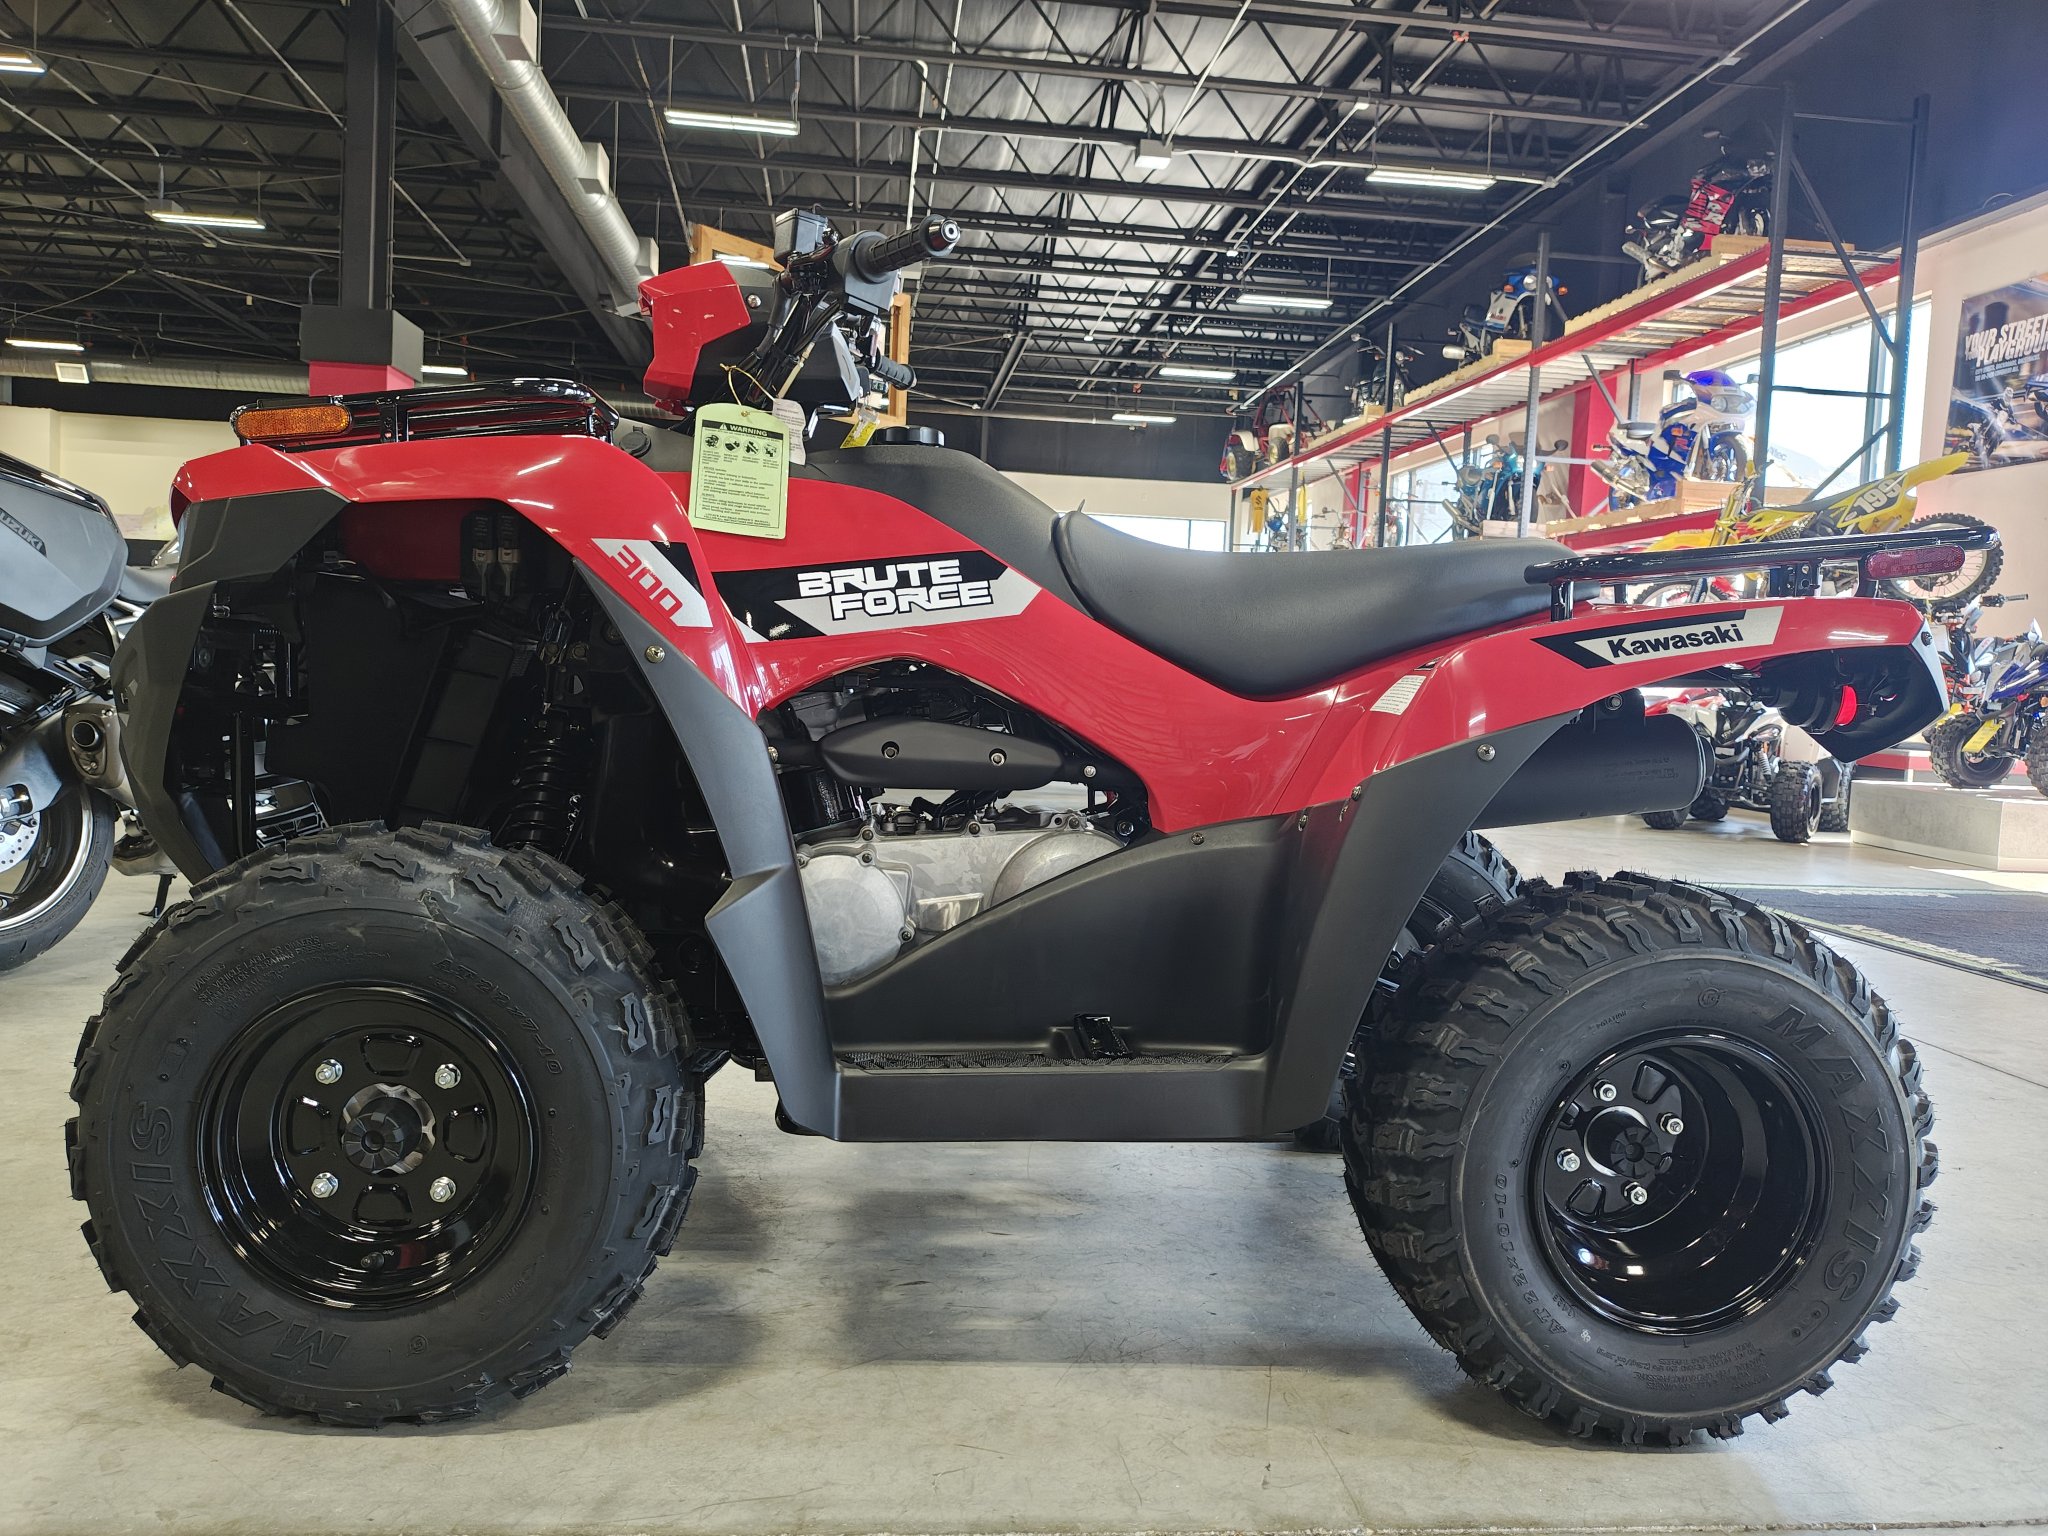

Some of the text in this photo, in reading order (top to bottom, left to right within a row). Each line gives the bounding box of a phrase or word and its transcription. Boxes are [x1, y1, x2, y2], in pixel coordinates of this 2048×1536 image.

[1966, 327, 1998, 355] YOUR
[729, 424, 768, 437] WARNING
[0, 509, 43, 551] UZUKI
[608, 544, 684, 619] 300
[797, 559, 963, 598] BRUTE
[831, 580, 993, 621] FORCE
[1607, 624, 1744, 659] Kawasaki
[1762, 1004, 1892, 1301] MAXXIS
[129, 1101, 352, 1369] MAXXIS
